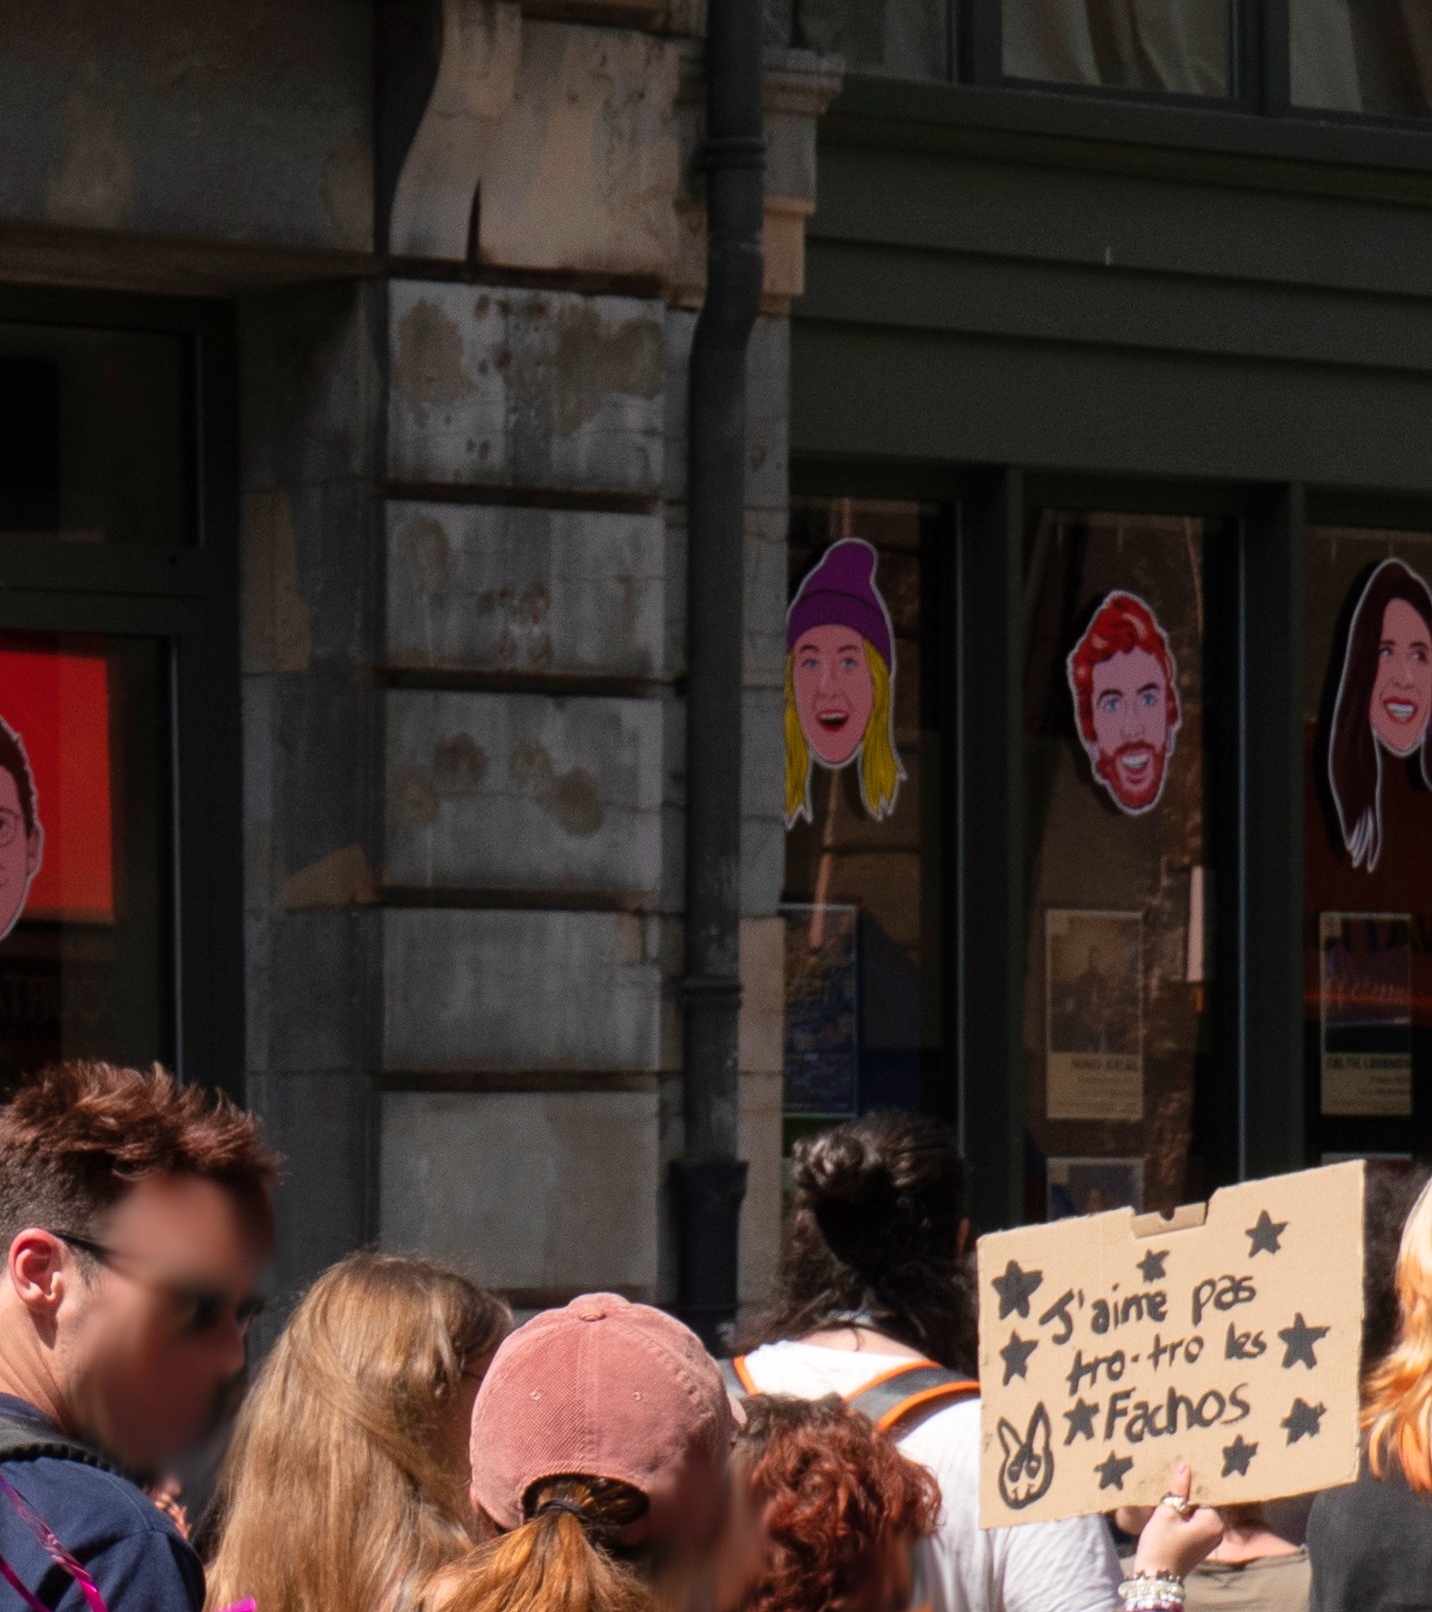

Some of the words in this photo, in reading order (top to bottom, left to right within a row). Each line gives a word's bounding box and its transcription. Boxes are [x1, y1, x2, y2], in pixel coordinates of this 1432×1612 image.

[1192, 1274, 1257, 1327] pas
[1067, 1334, 1204, 1396] tro-tro
[1225, 1321, 1268, 1361] les
[1104, 1383, 1250, 1444] Fachos
